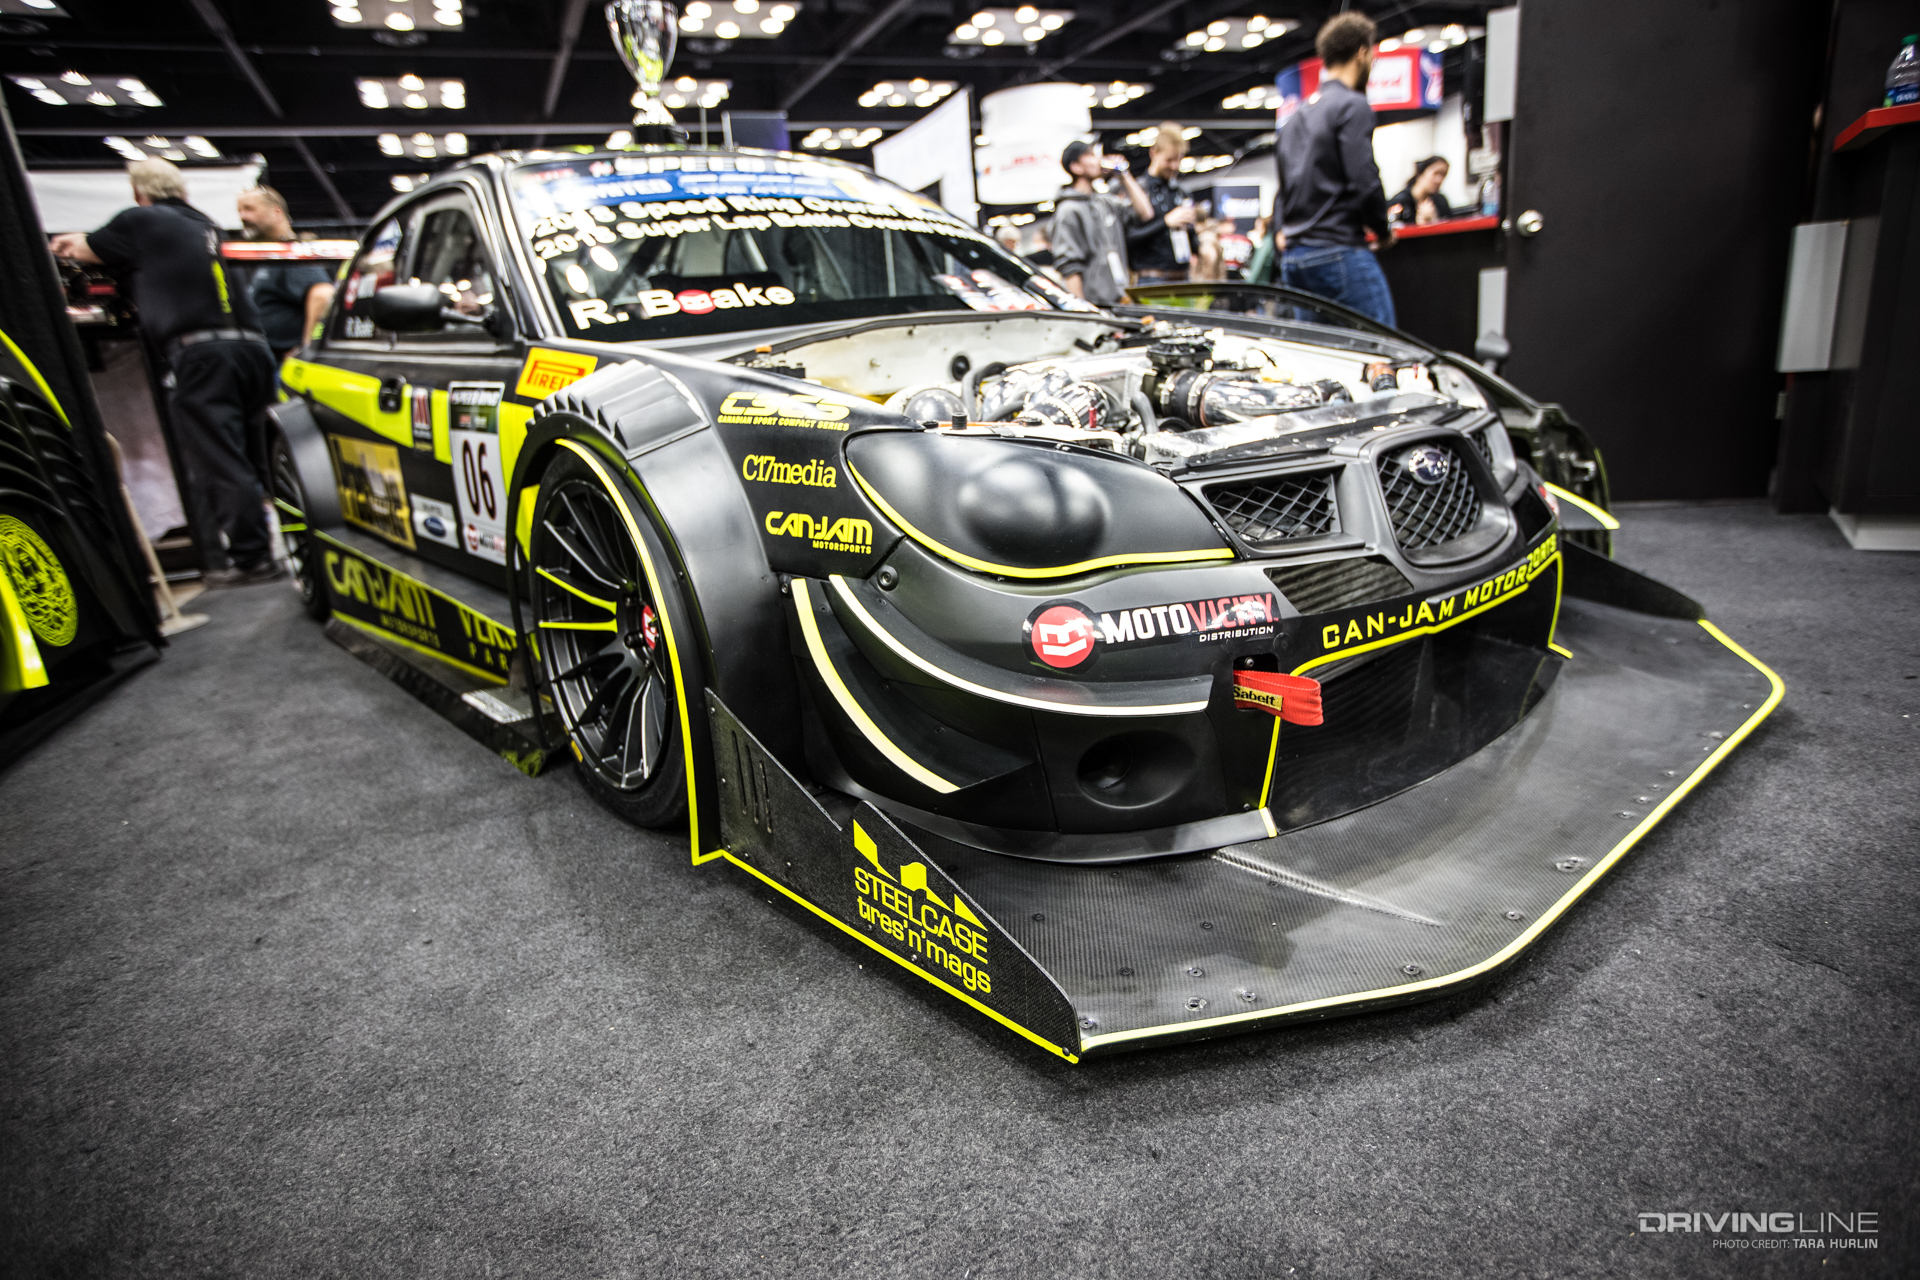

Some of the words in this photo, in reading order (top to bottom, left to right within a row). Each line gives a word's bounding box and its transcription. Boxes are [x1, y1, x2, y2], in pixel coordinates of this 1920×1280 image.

[534, 204, 617, 238] 208
[618, 196, 728, 221] Speed
[726, 195, 805, 214] Ring
[616, 217, 711, 238] Super
[710, 213, 772, 231] Lap
[768, 211, 851, 229] Battle
[568, 298, 630, 330] R.
[526, 360, 586, 391] PIREL
[717, 414, 753, 425] CANADIAN
[752, 416, 778, 425] SPORT
[777, 417, 817, 428] COMPACT
[816, 420, 850, 431] SERIES
[462, 439, 497, 521] 06
[742, 453, 837, 488] C17media
[812, 539, 872, 555] MOTORSPORTS
[1322, 595, 1455, 649] CAN-JAM
[1462, 532, 1557, 610] MOTORORTS
[1099, 593, 1276, 645] MOTOVICITY
[1198, 625, 1274, 643] DISTRIBUTION
[1233, 686, 1276, 707] Sabelt
[854, 866, 988, 965] STEELCASE
